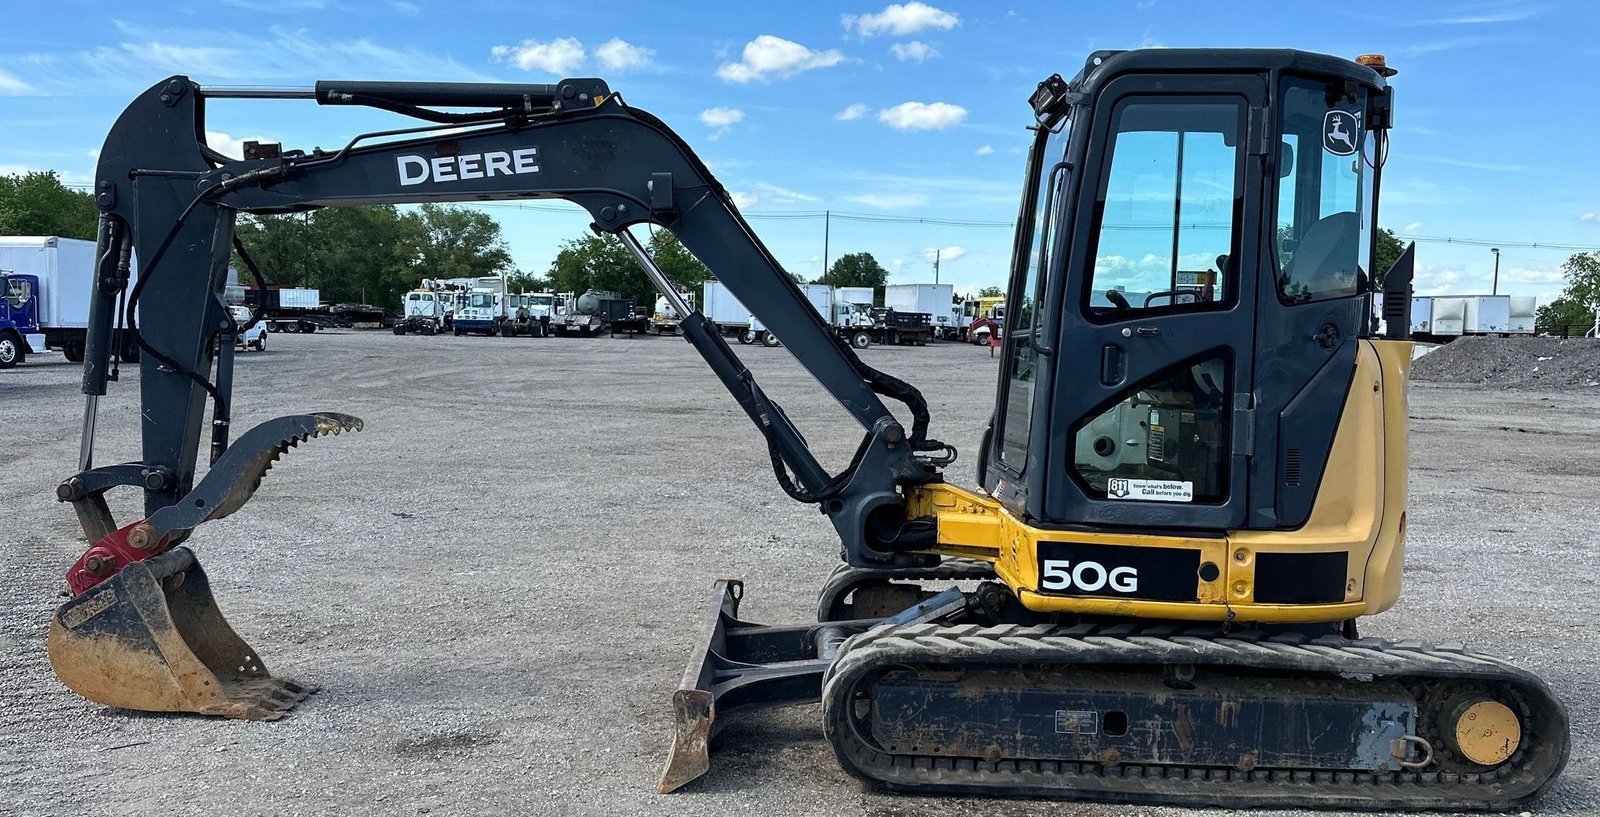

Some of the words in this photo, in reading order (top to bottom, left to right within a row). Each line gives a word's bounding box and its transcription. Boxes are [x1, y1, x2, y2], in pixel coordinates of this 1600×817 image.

[396, 148, 539, 186] DEERE
[1111, 480, 1128, 491] 811
[1042, 559, 1138, 593] 50G
